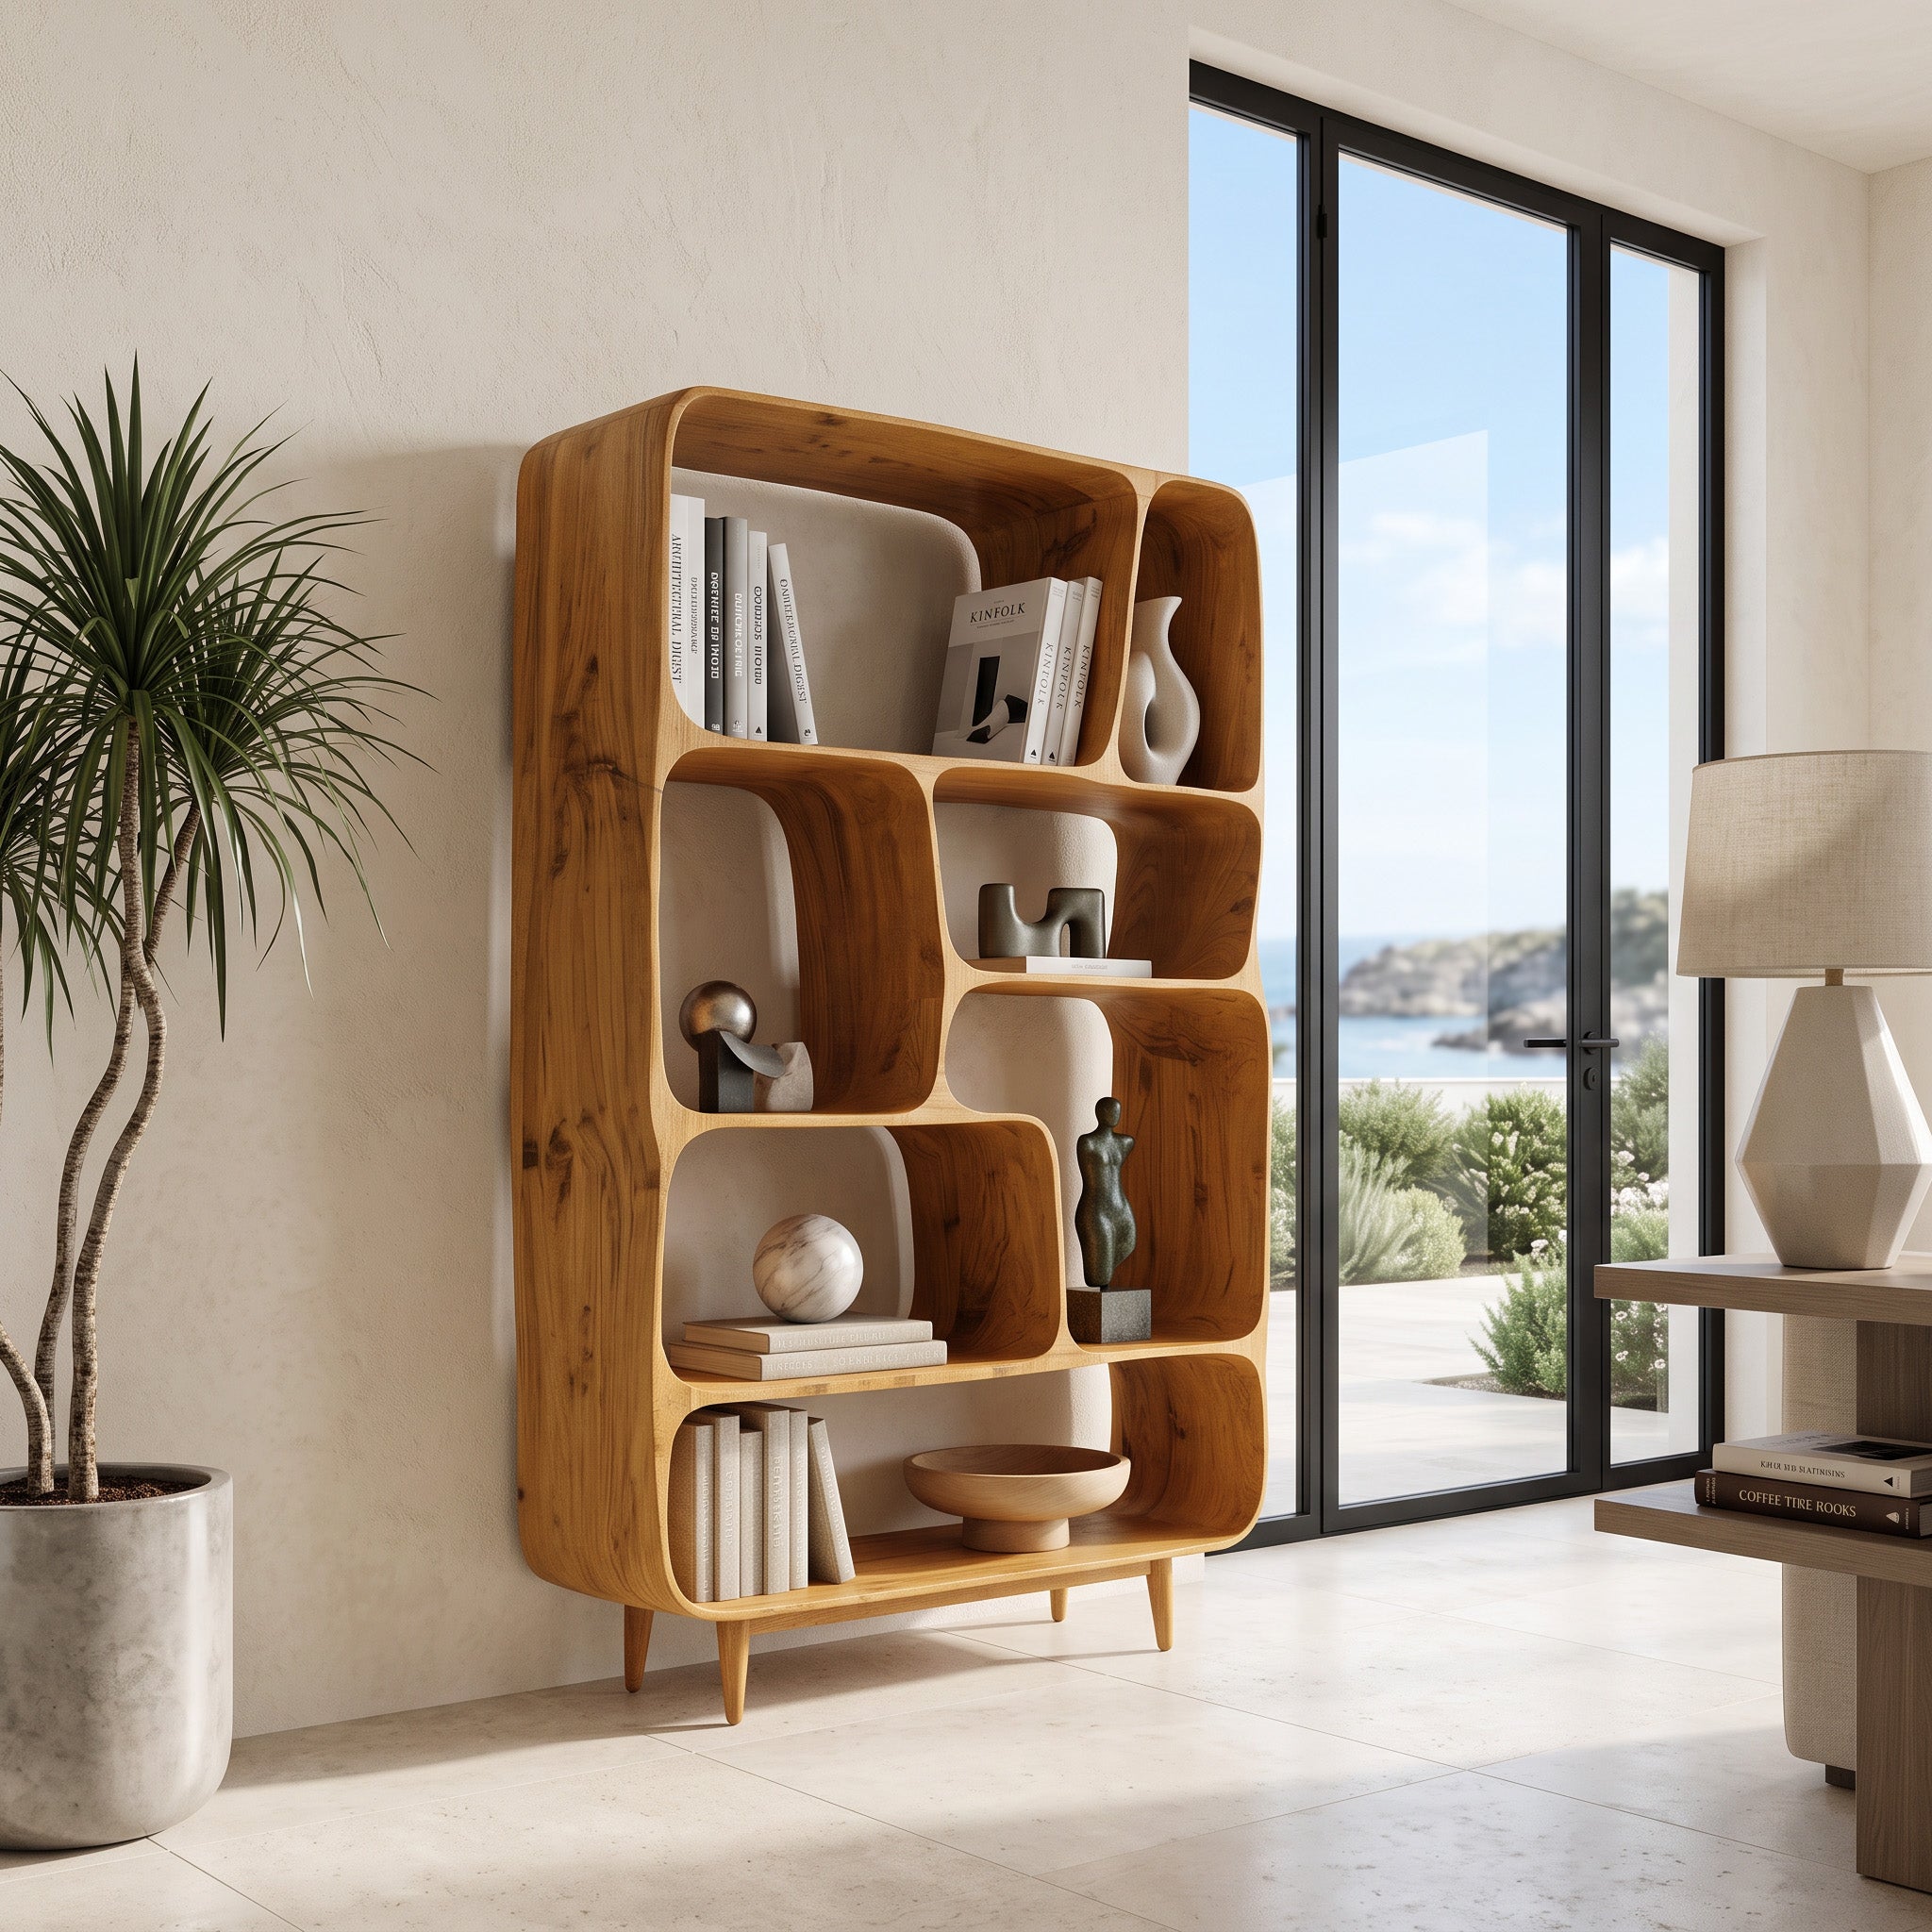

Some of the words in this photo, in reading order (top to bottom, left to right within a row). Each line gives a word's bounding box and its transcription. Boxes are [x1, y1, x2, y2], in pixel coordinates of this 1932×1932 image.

[970, 602, 1025, 623] KINFOLK
[1739, 1490, 1782, 1506] COFFEE
[1816, 1501, 1857, 1517] ROOKS
